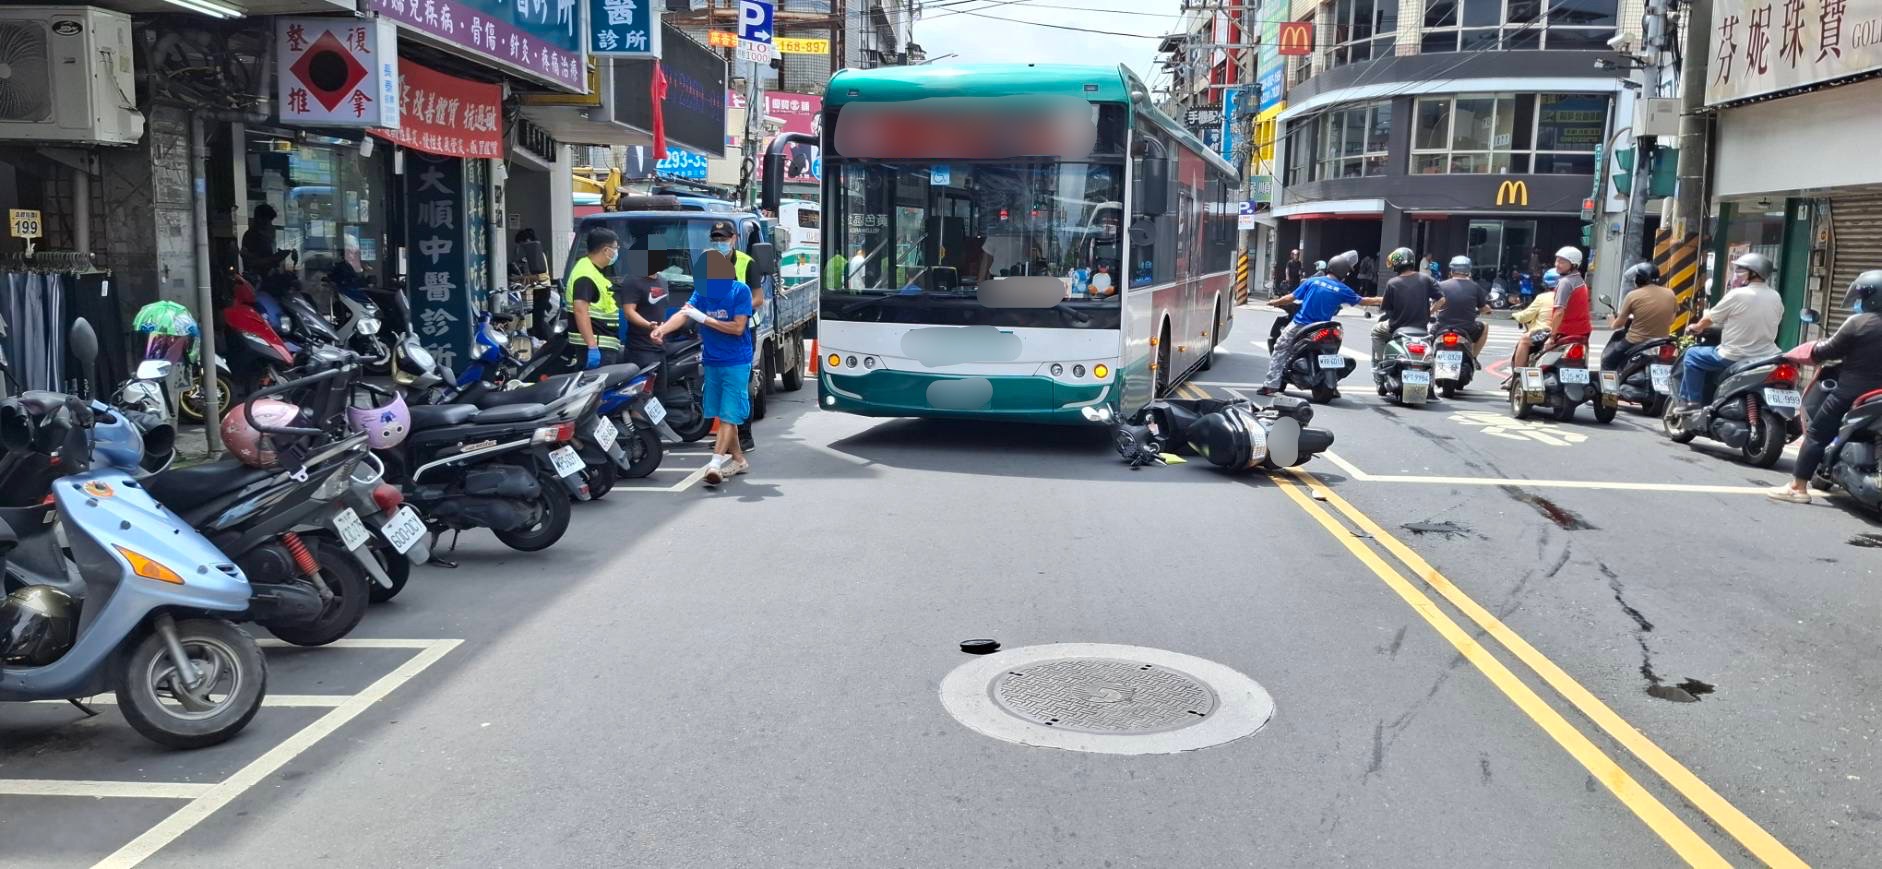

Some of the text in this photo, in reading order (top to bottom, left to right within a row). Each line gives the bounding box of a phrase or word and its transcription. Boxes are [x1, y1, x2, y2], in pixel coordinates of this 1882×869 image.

[739, 0, 765, 37] P
[597, 28, 648, 51] 診所
[1713, 0, 1847, 87] 芬妮珠寶
[15, 220, 38, 234] 199
[416, 165, 459, 370] 大順中醫診所
